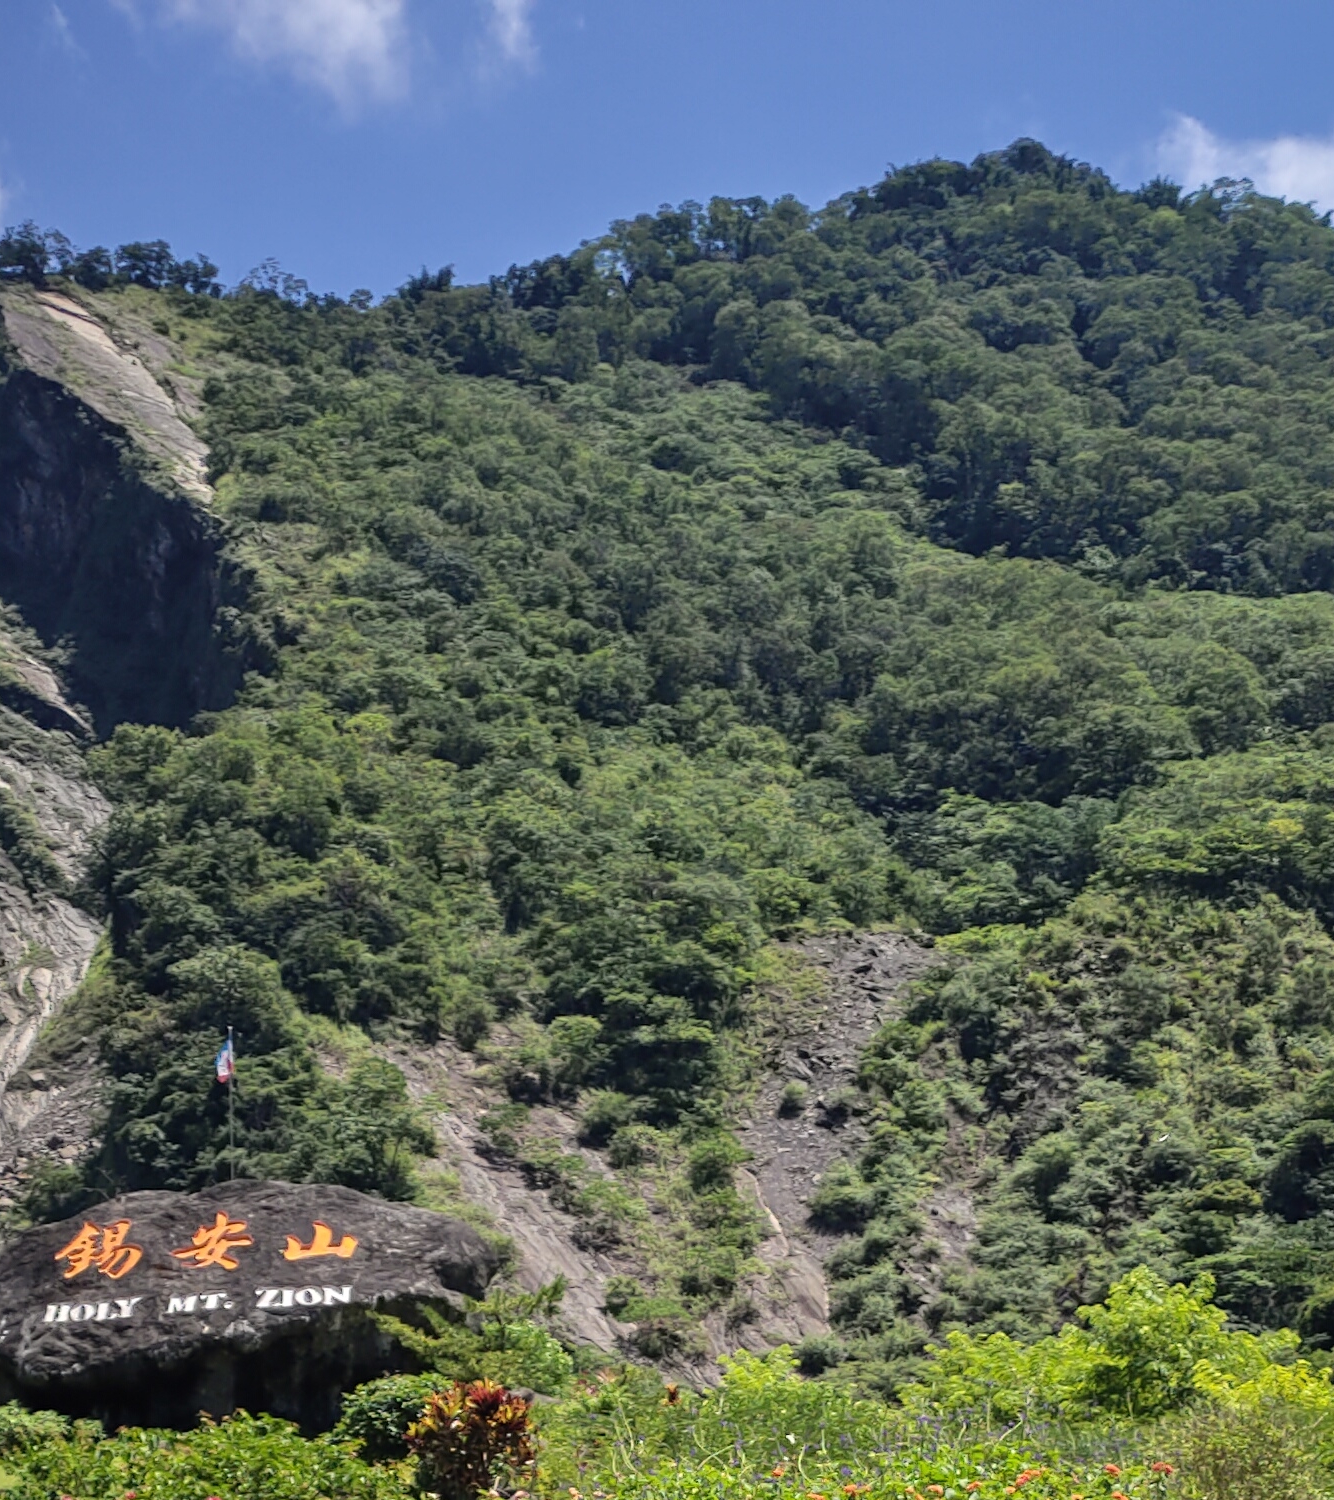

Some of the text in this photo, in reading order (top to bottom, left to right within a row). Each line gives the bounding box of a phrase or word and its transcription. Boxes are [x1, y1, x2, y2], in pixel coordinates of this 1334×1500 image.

[54, 1212, 359, 1279] 錫安山
[43, 1284, 354, 1322] HOLY MT. ZION
